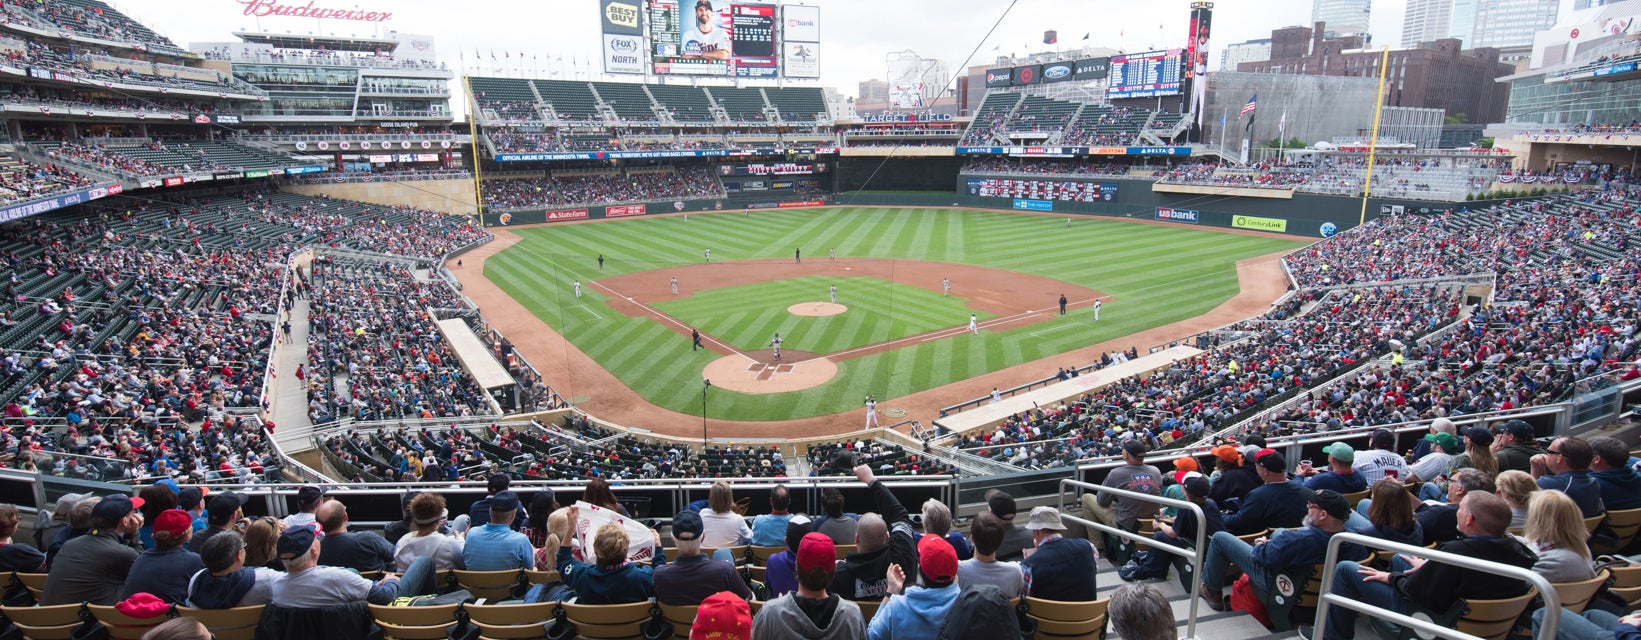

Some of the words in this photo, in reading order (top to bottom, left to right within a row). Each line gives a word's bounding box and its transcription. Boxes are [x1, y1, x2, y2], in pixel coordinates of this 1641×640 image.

[236, 0, 392, 21] Budweiser
[610, 6, 636, 16] BEST
[612, 14, 634, 24] BUY
[616, 40, 632, 48] FOX
[612, 55, 638, 64] NORTH
[1050, 68, 1064, 76] Ford
[1083, 64, 1106, 72] DELTA
[994, 74, 1010, 82] pepsi
[864, 114, 907, 122] TARGET
[918, 114, 952, 122] FIELD
[1248, 220, 1281, 228] CenturyLink
[1373, 456, 1402, 468] MAUER
